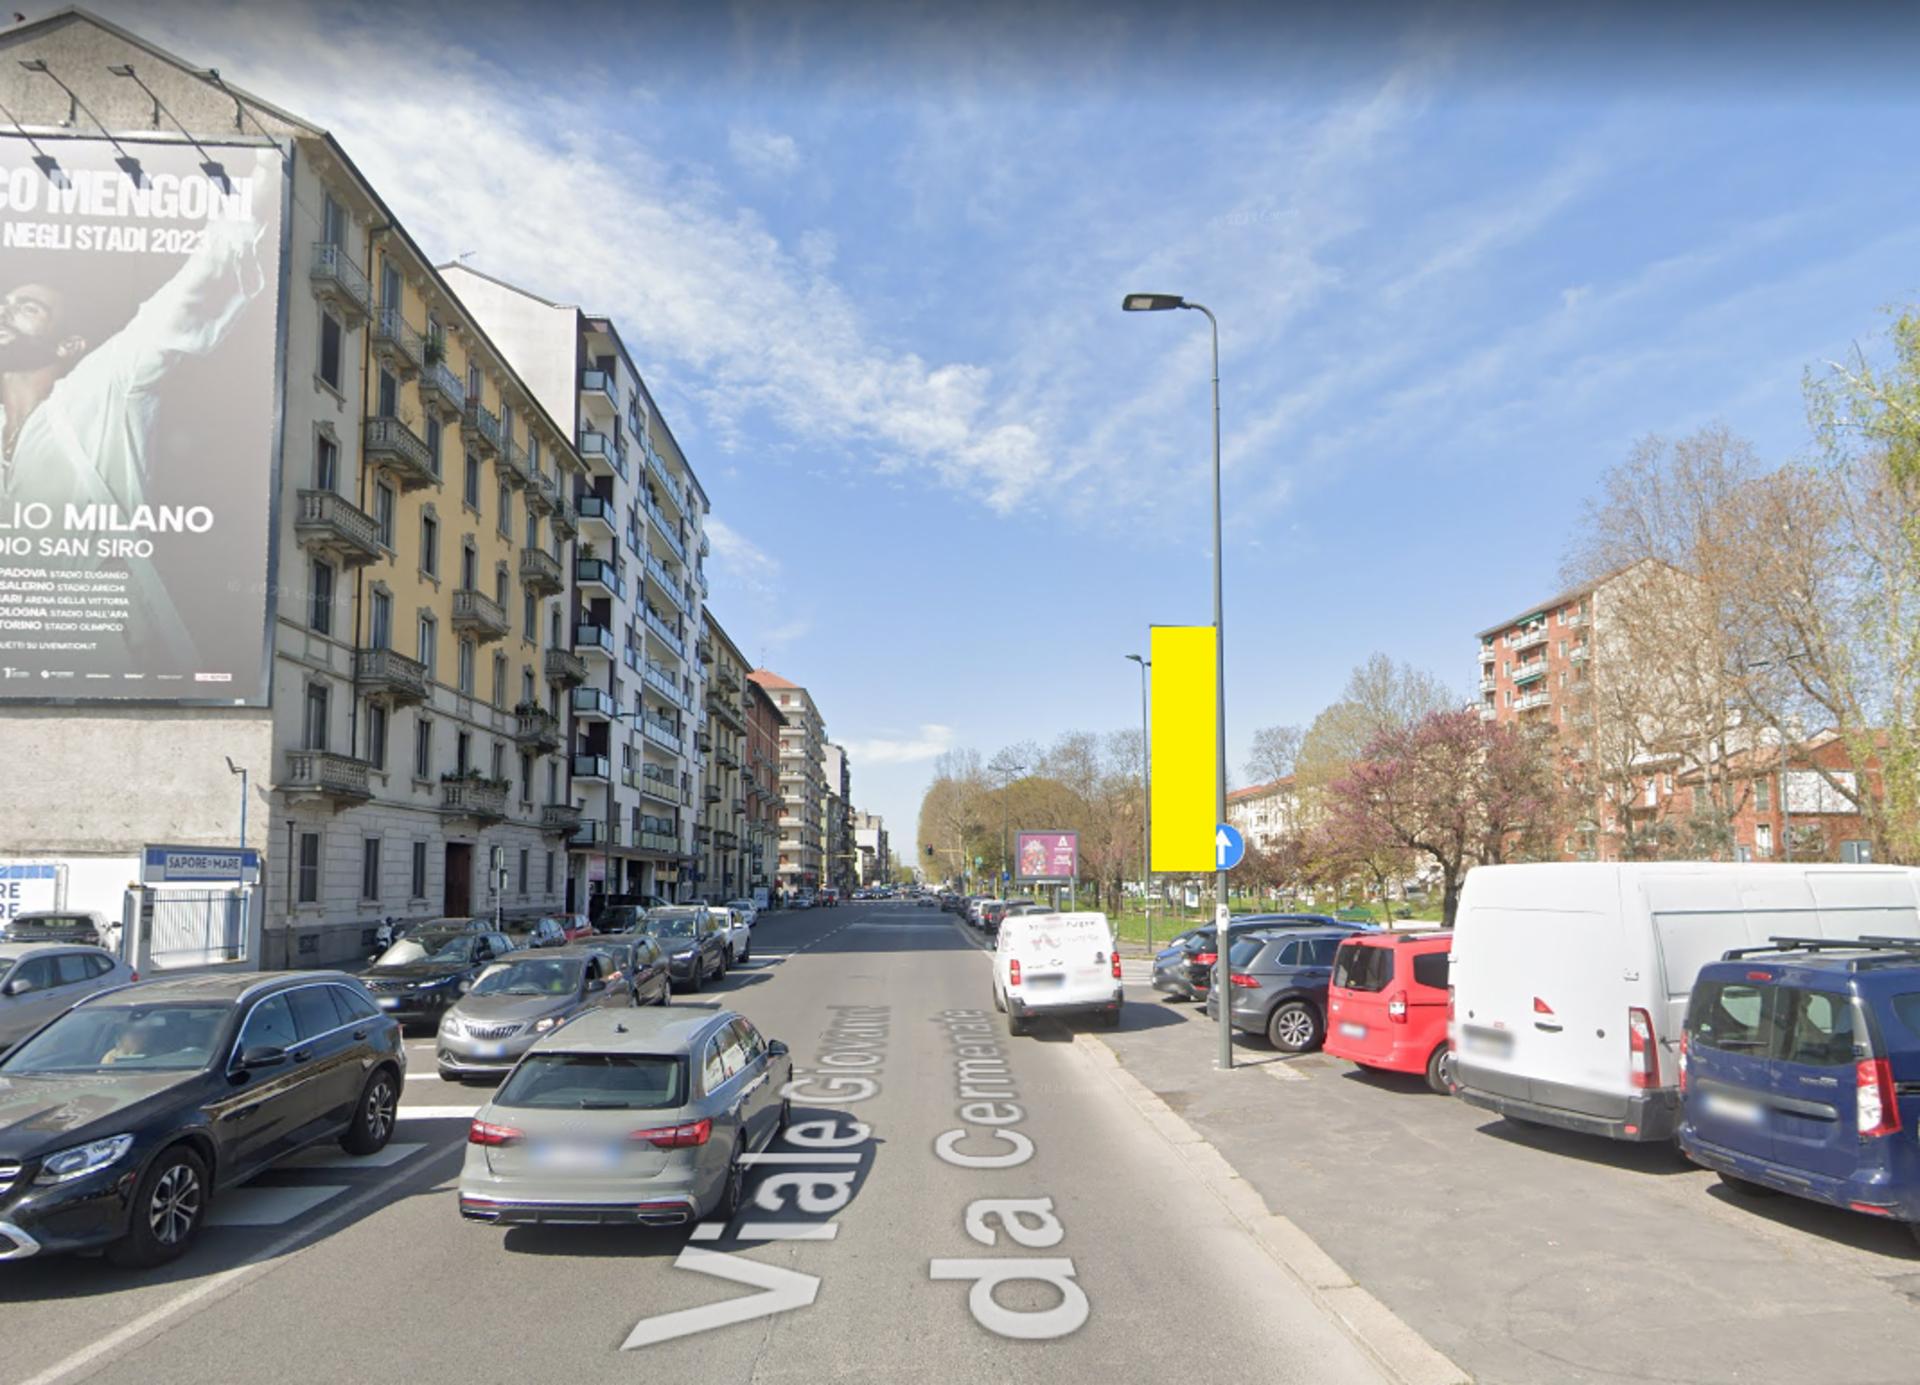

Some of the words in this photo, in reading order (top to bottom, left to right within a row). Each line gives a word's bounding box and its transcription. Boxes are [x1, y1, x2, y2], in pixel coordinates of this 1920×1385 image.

[47, 168, 254, 221] MENGONI
[3, 222, 71, 249] NEGLI
[76, 225, 147, 252] STADI
[63, 503, 214, 532] MILANO
[39, 537, 89, 557] SAN
[96, 538, 154, 558] SIRO
[49, 570, 82, 579] STADIO
[57, 584, 90, 592] STADIO
[91, 584, 126, 592] ARECHI
[0, 594, 23, 604] ARI
[25, 596, 56, 604] ARENA
[57, 596, 86, 605] DELLA
[88, 597, 130, 606] VITTORIA
[49, 609, 83, 618] STADIO
[44, 623, 78, 631] STADIO
[79, 623, 124, 632] OLIMPICO
[168, 857, 208, 869] SAPORE
[213, 858, 240, 870] MARE
